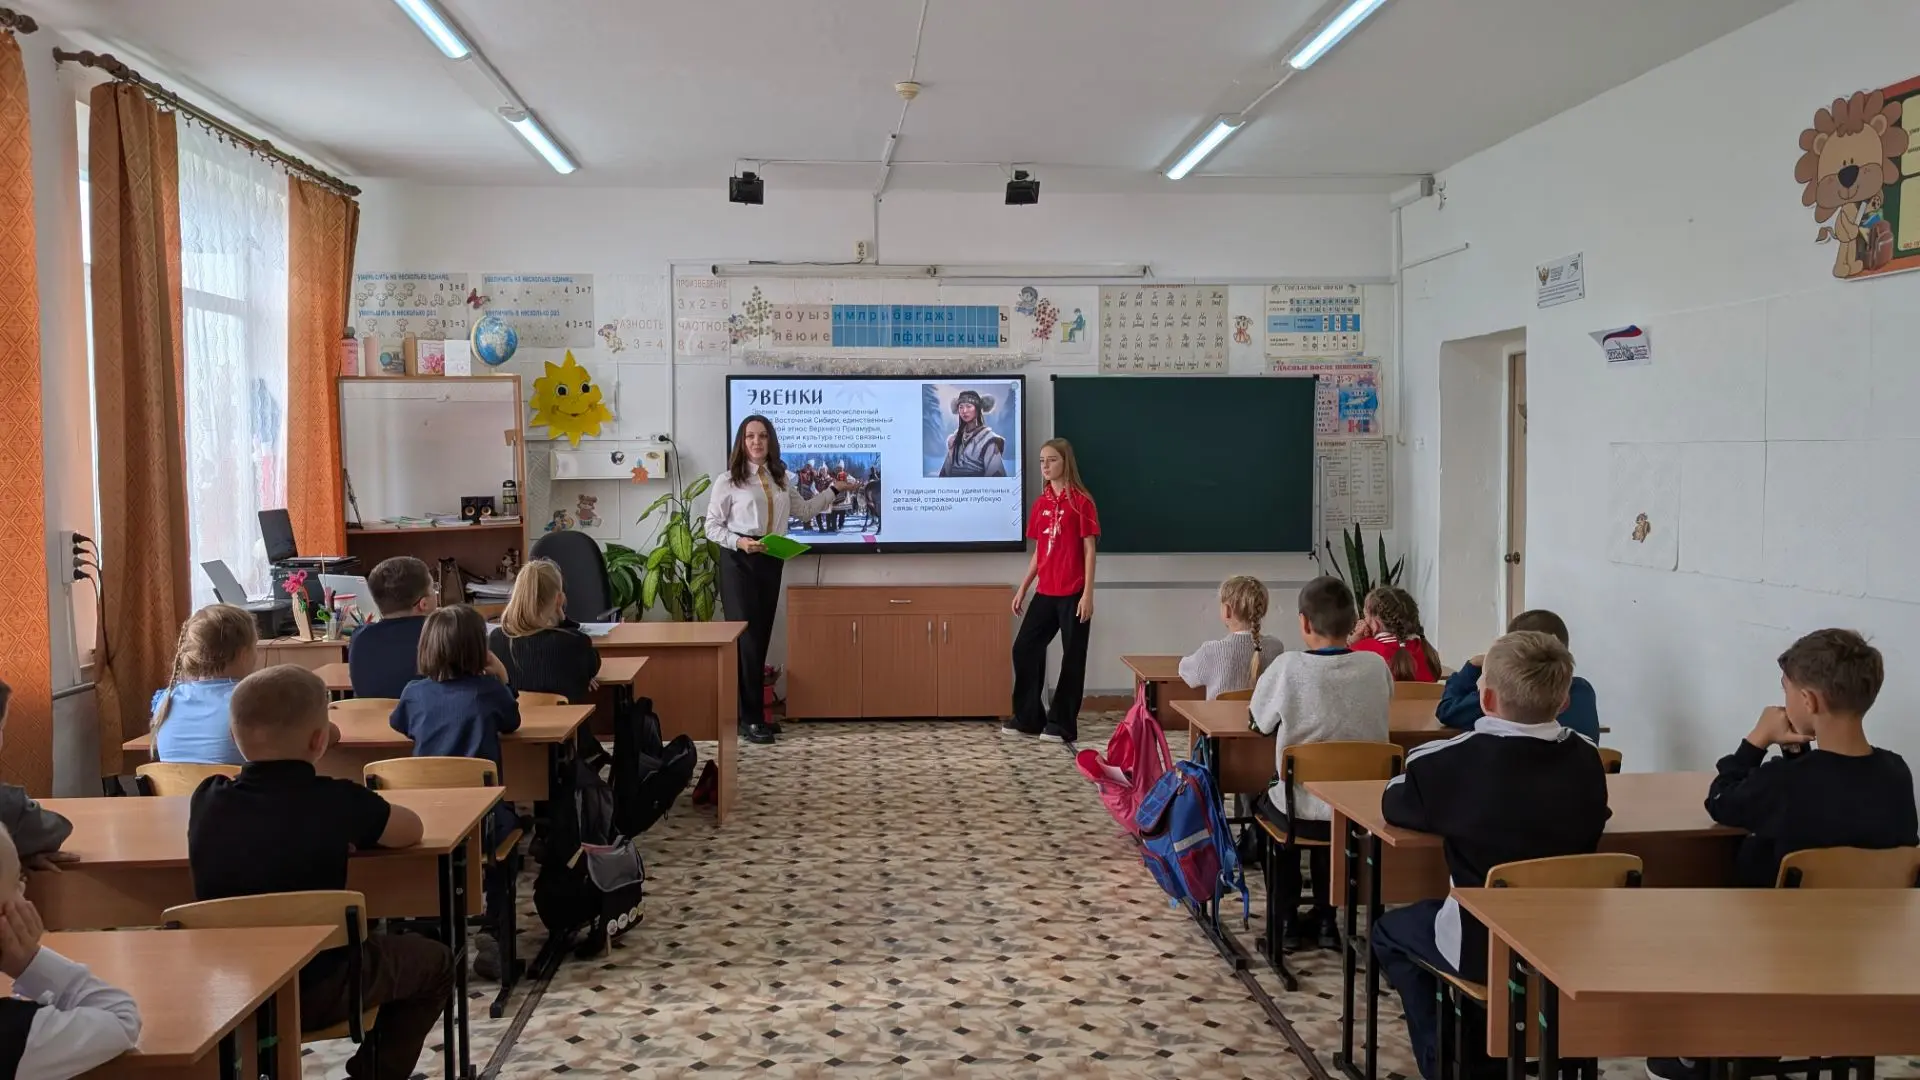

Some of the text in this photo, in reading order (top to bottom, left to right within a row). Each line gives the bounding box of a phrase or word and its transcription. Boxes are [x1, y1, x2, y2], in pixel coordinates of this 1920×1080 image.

[676, 280, 727, 288] ПРОИЗВЕДЕНИЕ
[678, 299, 684, 309] 3
[700, 299, 706, 309] 2
[722, 299, 728, 309] 6
[797, 312, 804, 322] у
[935, 312, 944, 320] ж
[678, 321, 728, 331] ЧАСТНОЕ
[796, 332, 806, 340] ю
[823, 332, 830, 341] е
[903, 331, 912, 344] ф
[935, 333, 944, 342] ш
[948, 333, 954, 342] с
[968, 333, 975, 344] ц
[634, 339, 640, 349] 3
[657, 339, 663, 349] 4
[678, 340, 684, 350] 8
[697, 341, 703, 351] 4
[722, 341, 728, 351] 2
[747, 389, 823, 405] ЭВЕНКИ
